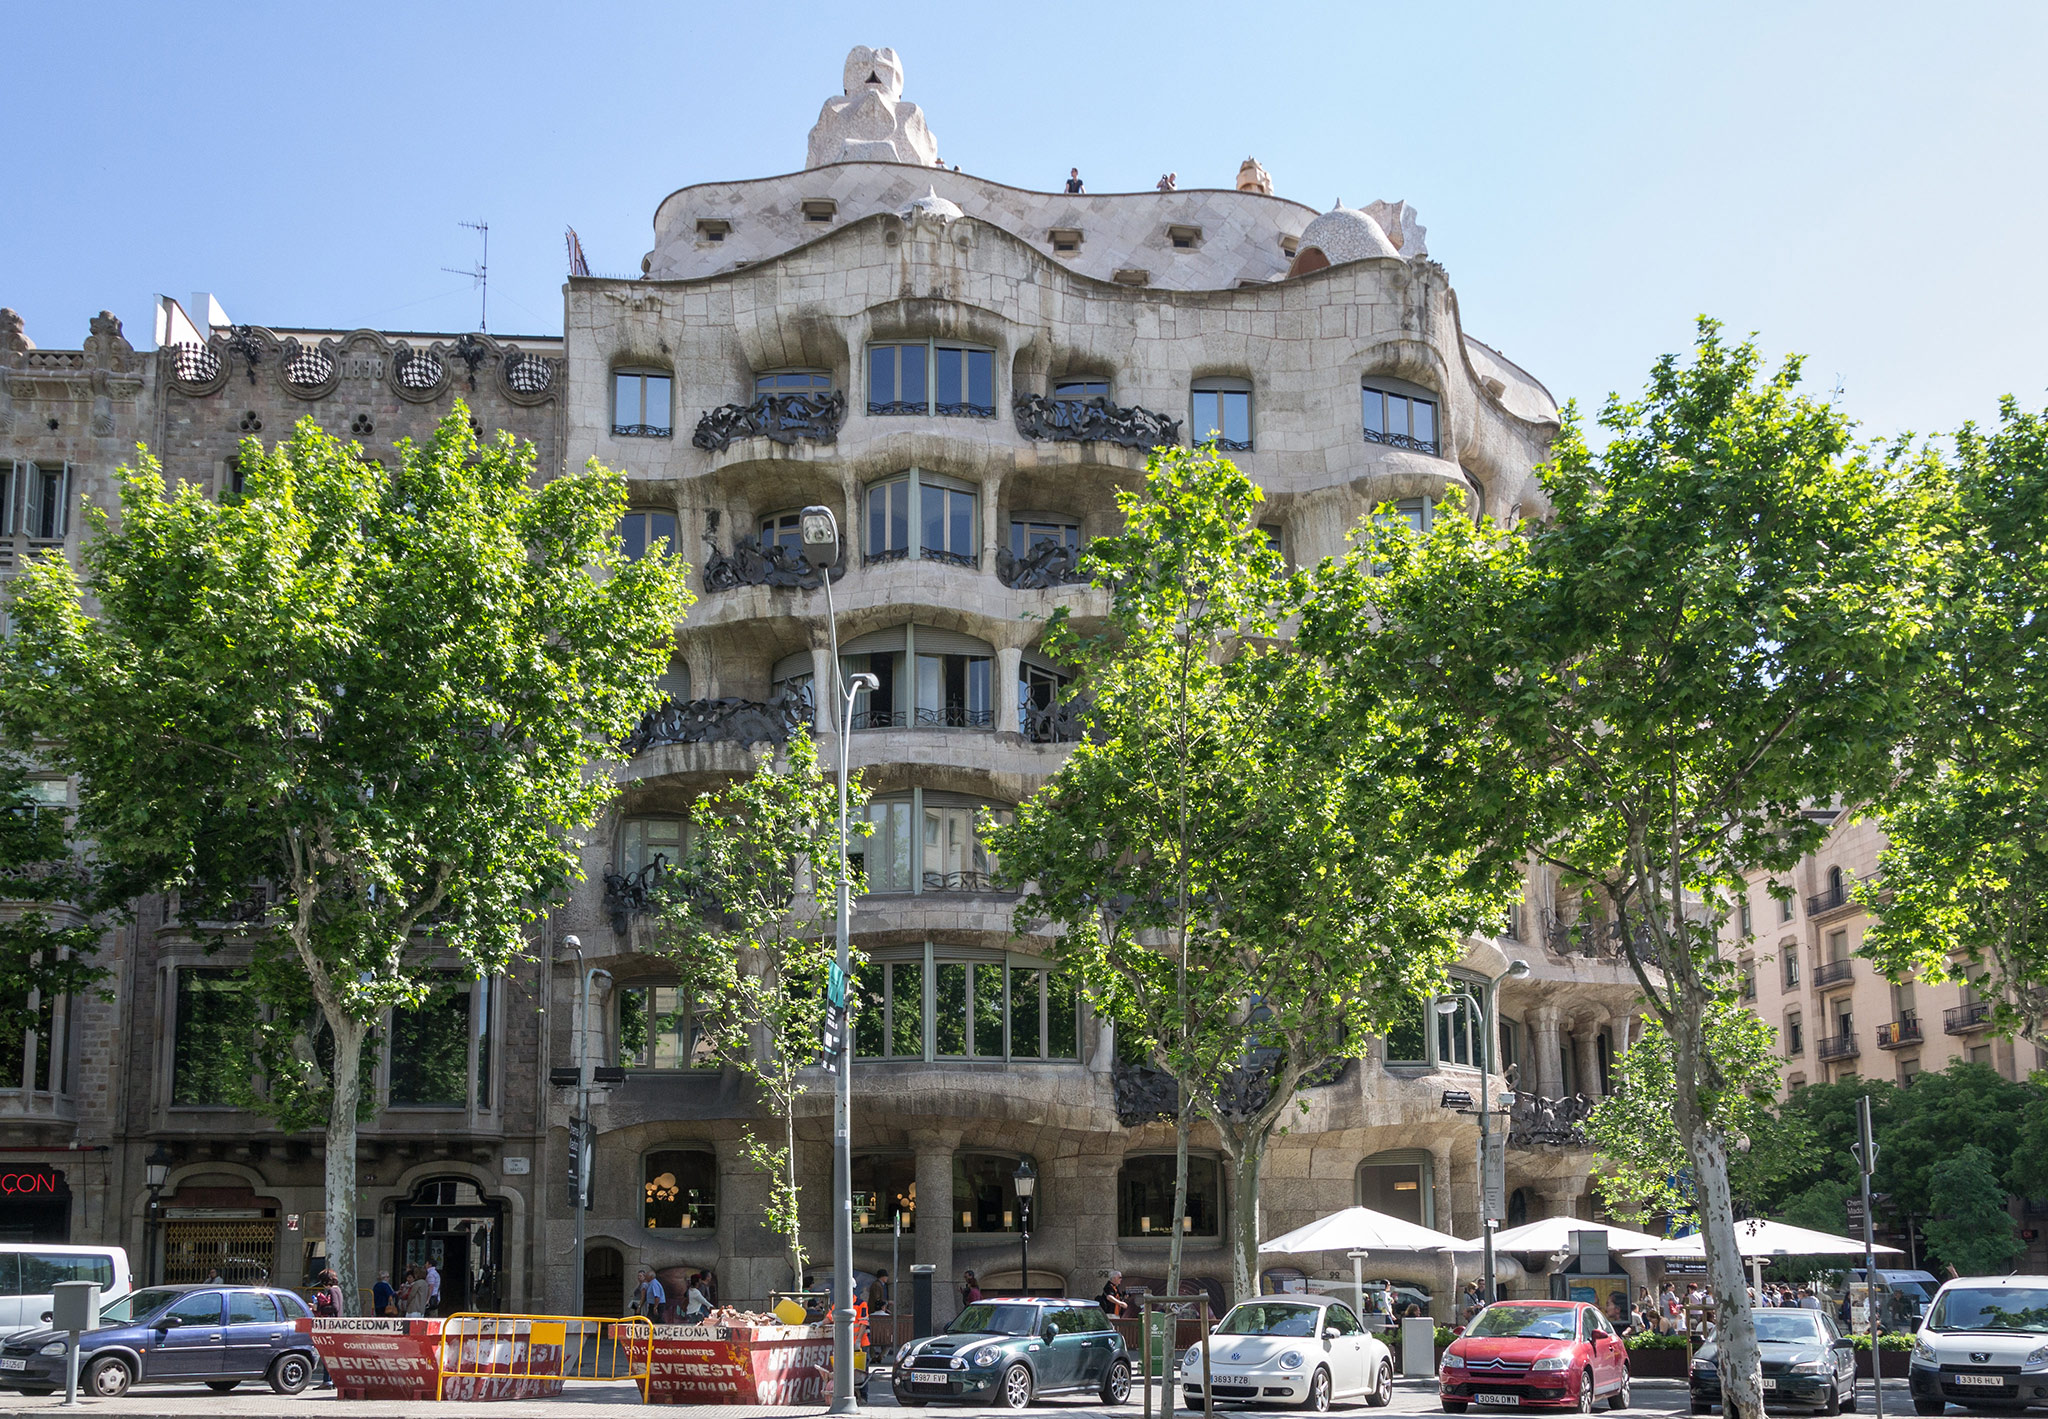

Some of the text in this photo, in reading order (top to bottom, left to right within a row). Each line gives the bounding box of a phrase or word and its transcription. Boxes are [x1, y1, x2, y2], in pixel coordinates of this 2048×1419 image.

[342, 359, 384, 379] 1898
[0, 1173, 55, 1195] ÇON
[328, 1319, 390, 1331] BARCELONA
[644, 1326, 710, 1338] BARCELONA
[343, 1342, 399, 1350] CONTAINERS
[655, 1347, 716, 1356] CONTAINERS
[340, 1356, 419, 1371] EVEREST
[649, 1362, 736, 1377] EVEREST
[933, 1374, 946, 1382] FVP
[1763, 1380, 1775, 1388] UJ
[1961, 1376, 1983, 1384] 3316
[652, 1380, 672, 1390] 93
[672, 1381, 695, 1391] 712
[697, 1382, 716, 1392] 04
[1479, 1395, 1500, 1404] 3094
